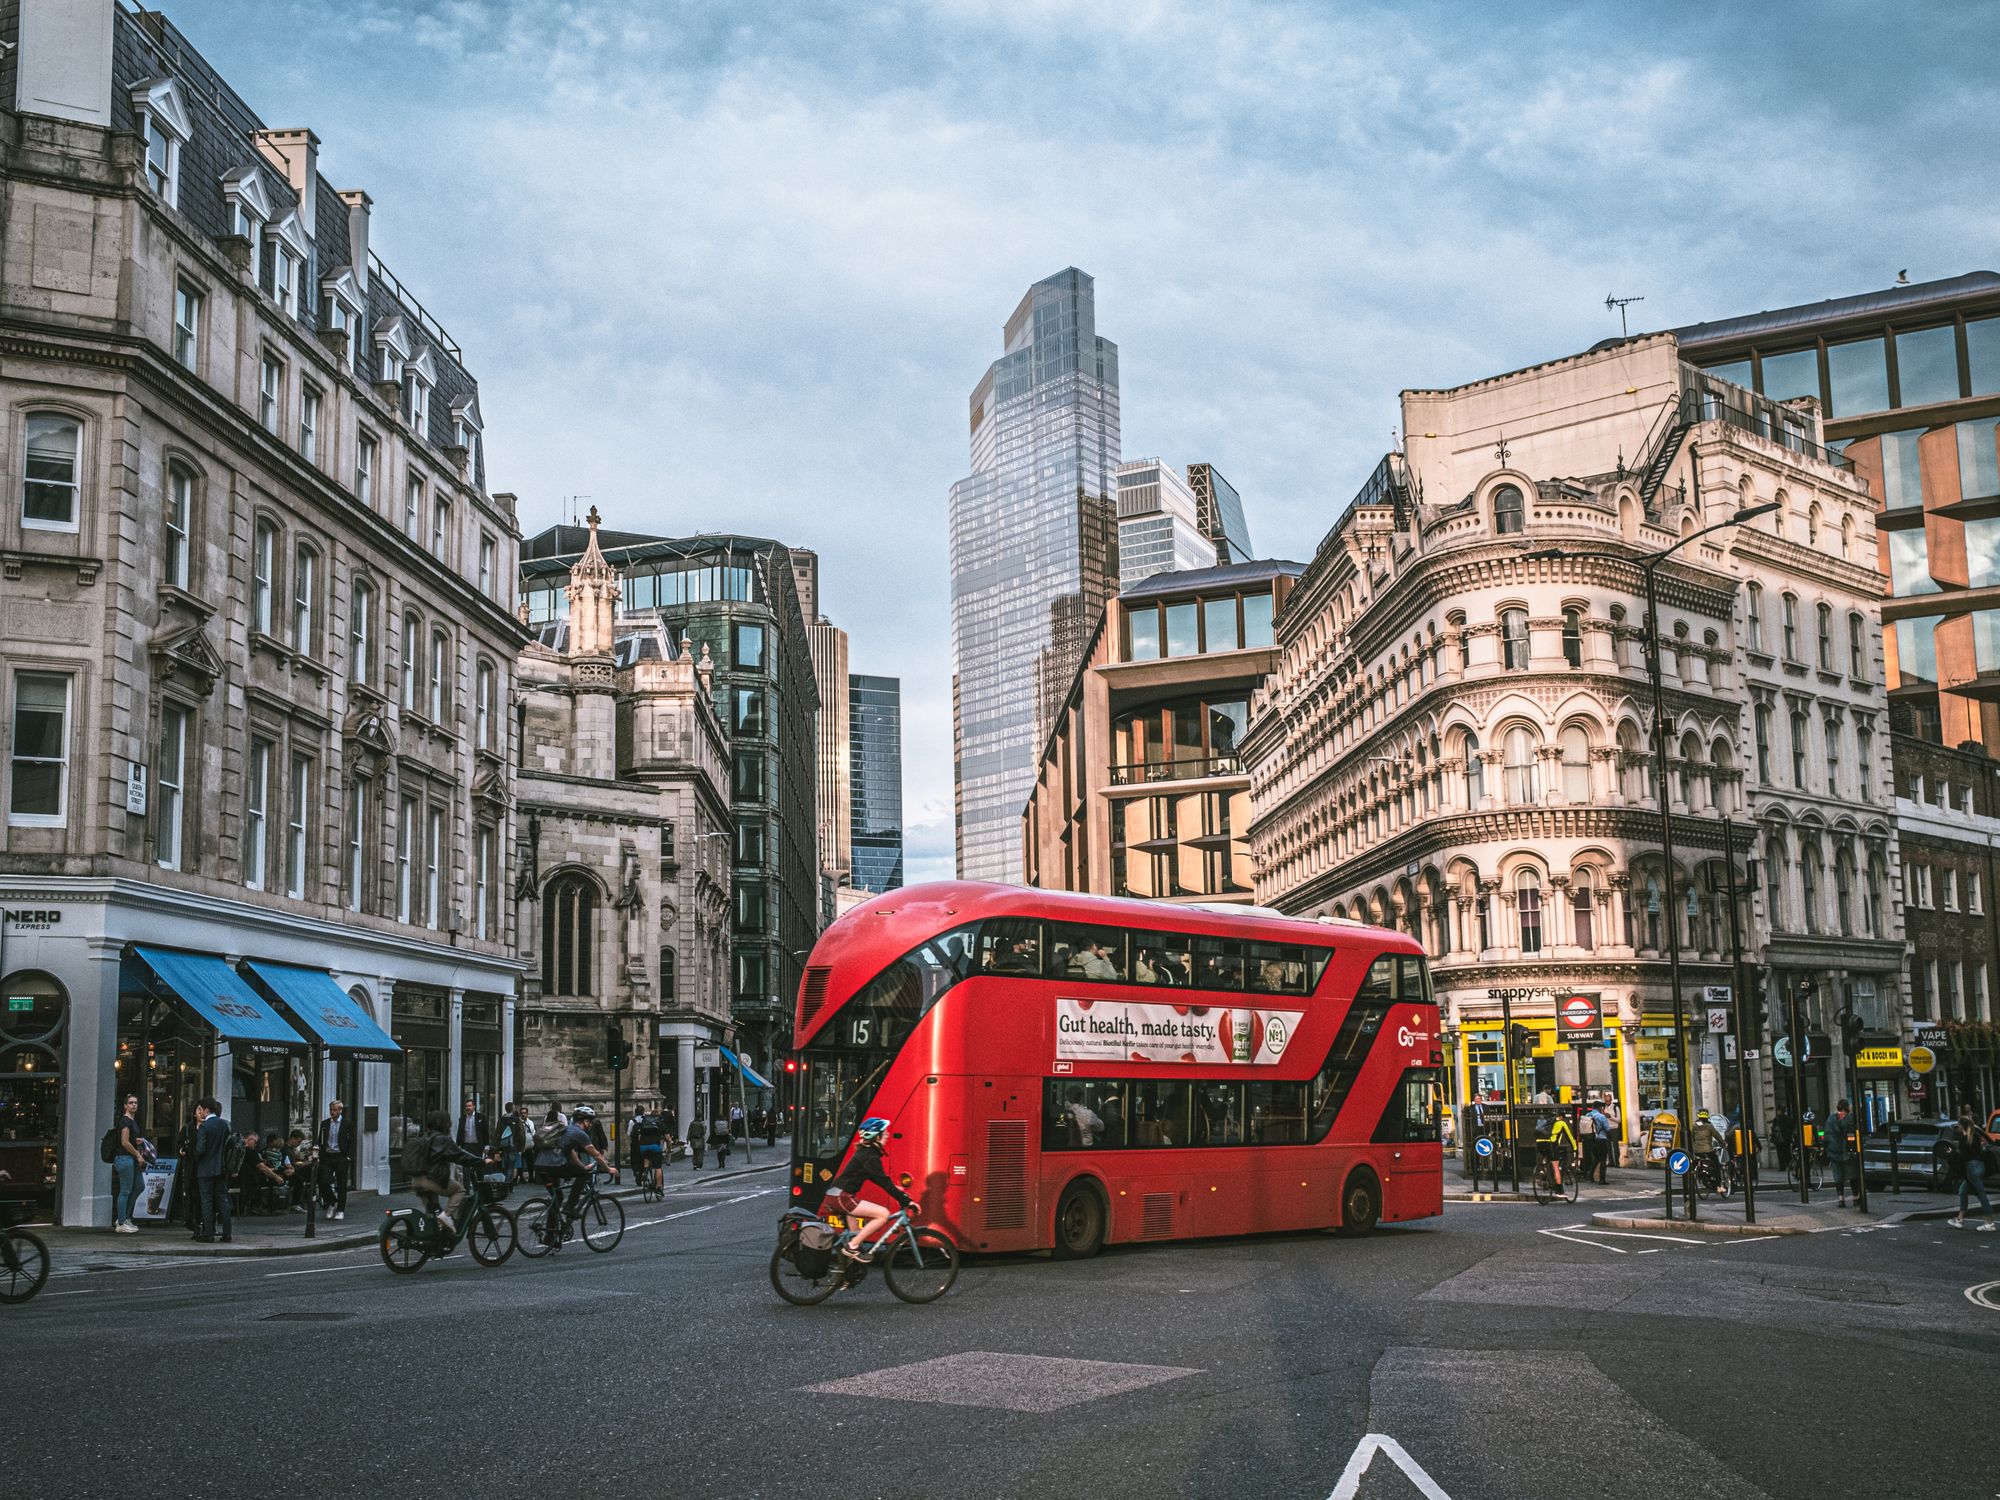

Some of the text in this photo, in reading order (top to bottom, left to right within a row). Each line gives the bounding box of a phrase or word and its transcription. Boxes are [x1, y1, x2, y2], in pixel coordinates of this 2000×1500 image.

[5, 910, 61, 922] NERO
[211, 1004, 263, 1019] NERO
[852, 1020, 870, 1044] 15
[1059, 1014, 1086, 1033] Gut
[1089, 1015, 1138, 1038] health,
[1141, 1019, 1178, 1037] made
[1180, 1021, 1216, 1041] tasty.
[1921, 1031, 1947, 1039] VAPE
[1872, 1052, 1888, 1060] BOOZE
[1889, 1052, 1898, 1060] HUB
